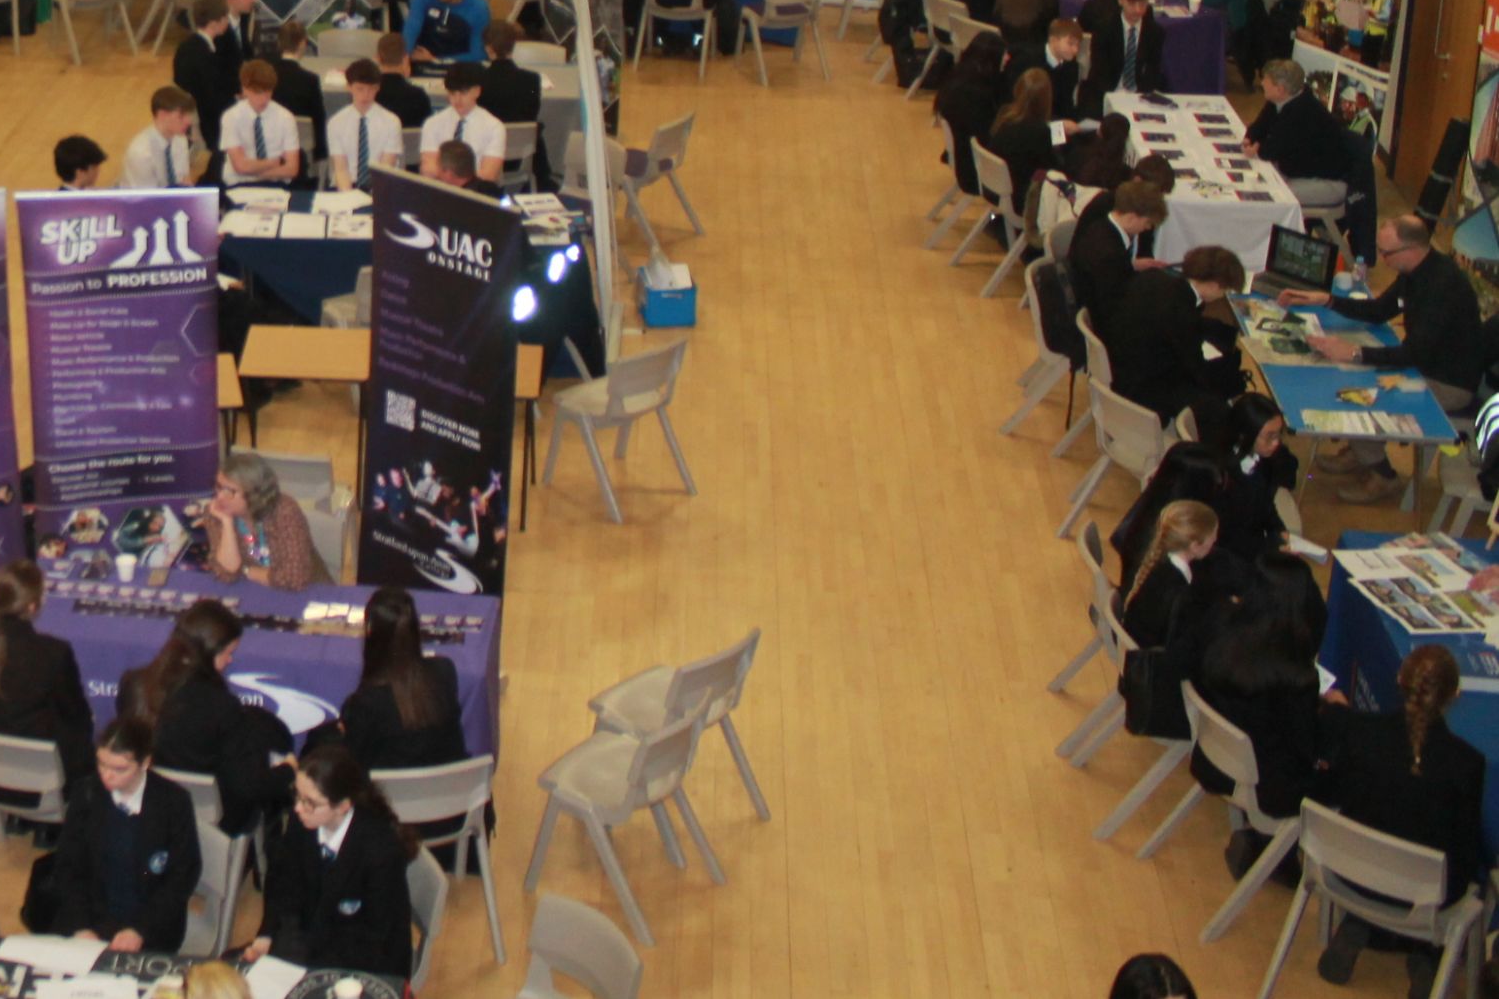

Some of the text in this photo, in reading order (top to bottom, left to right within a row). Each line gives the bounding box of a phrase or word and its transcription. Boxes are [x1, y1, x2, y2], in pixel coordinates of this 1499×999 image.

[40, 215, 123, 245] SKILL
[57, 240, 97, 265] UP
[440, 225, 494, 268] UAC
[31, 267, 207, 295] Passion to PROFESSION
[427, 251, 492, 283] ONSTAGE
[420, 421, 481, 452] AND APPLY NOW
[421, 408, 481, 440] DISCOVER MORE
[48, 463, 86, 474] Choose
[88, 459, 105, 468] the
[107, 457, 135, 467] route
[137, 455, 151, 465] for
